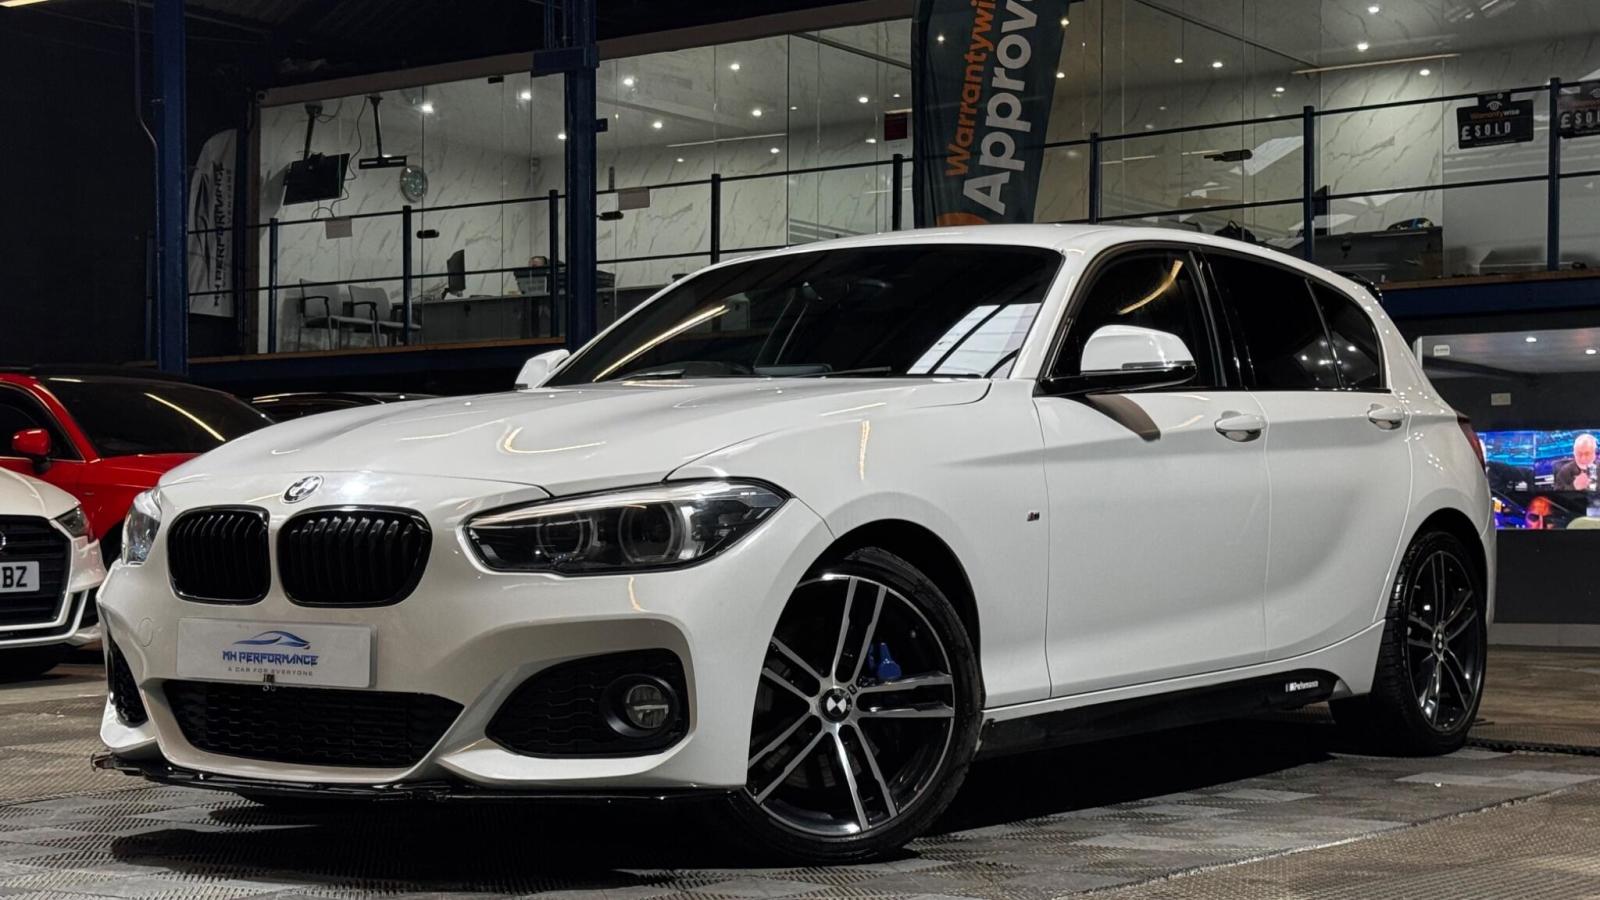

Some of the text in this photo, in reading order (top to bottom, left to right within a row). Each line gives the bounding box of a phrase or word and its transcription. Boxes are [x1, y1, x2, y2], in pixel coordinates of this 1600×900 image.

[963, 0, 1038, 216] Approv
[223, 651, 318, 666] MH PERFORMANCE
